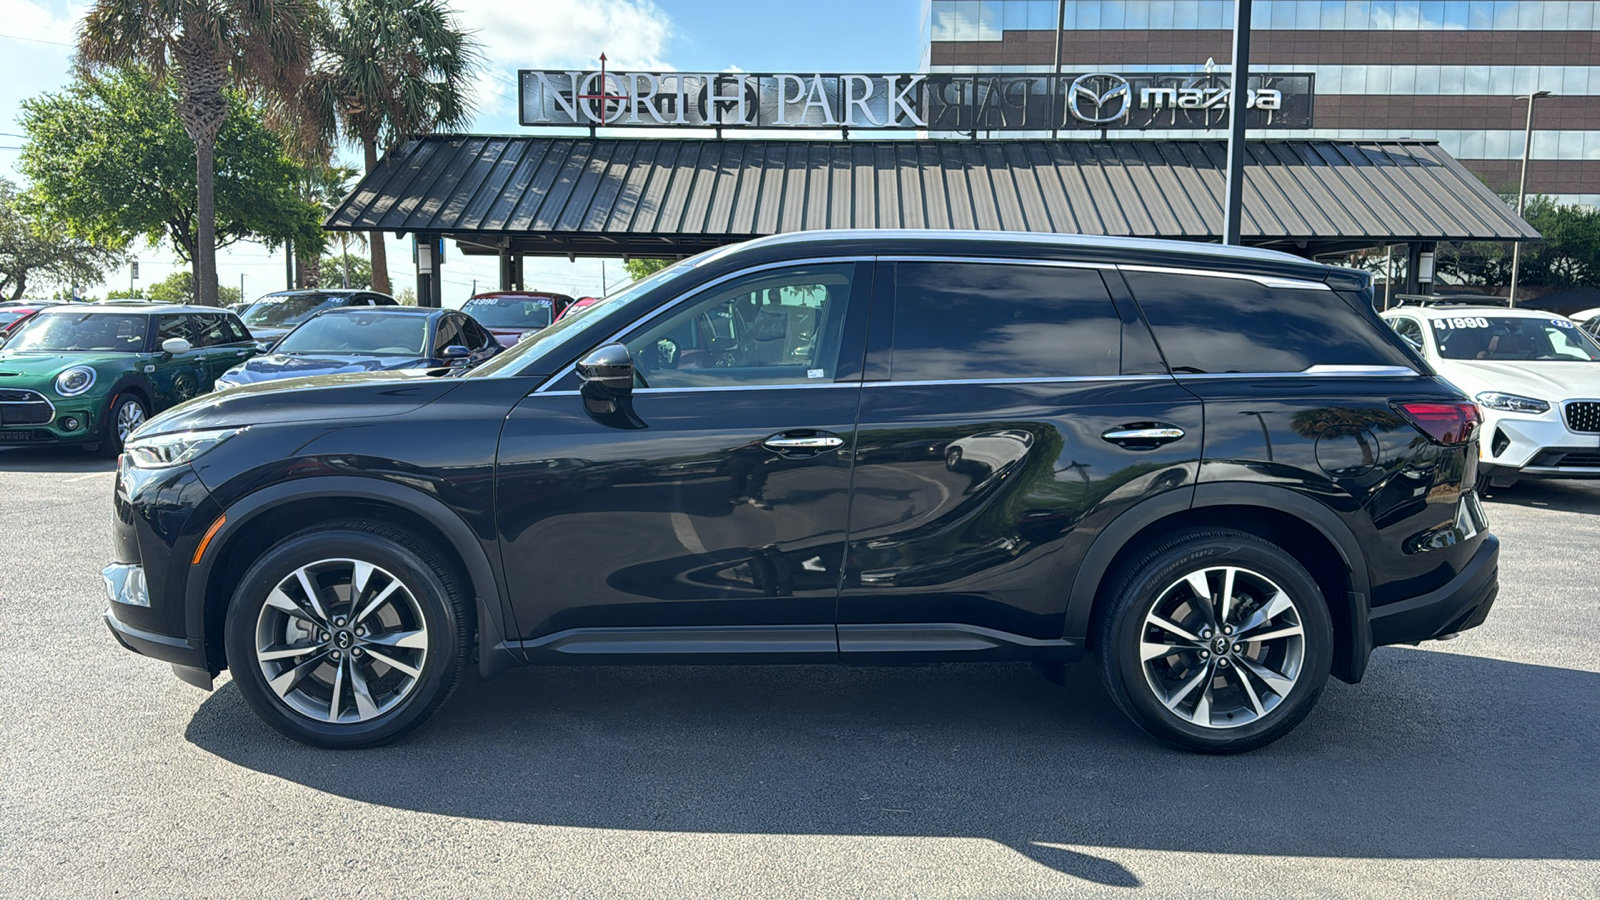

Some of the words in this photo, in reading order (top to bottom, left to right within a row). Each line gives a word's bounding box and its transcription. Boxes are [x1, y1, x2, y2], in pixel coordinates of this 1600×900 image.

[530, 71, 752, 126] NORTH
[771, 73, 928, 127] PARK
[1434, 318, 1489, 329] 41990
